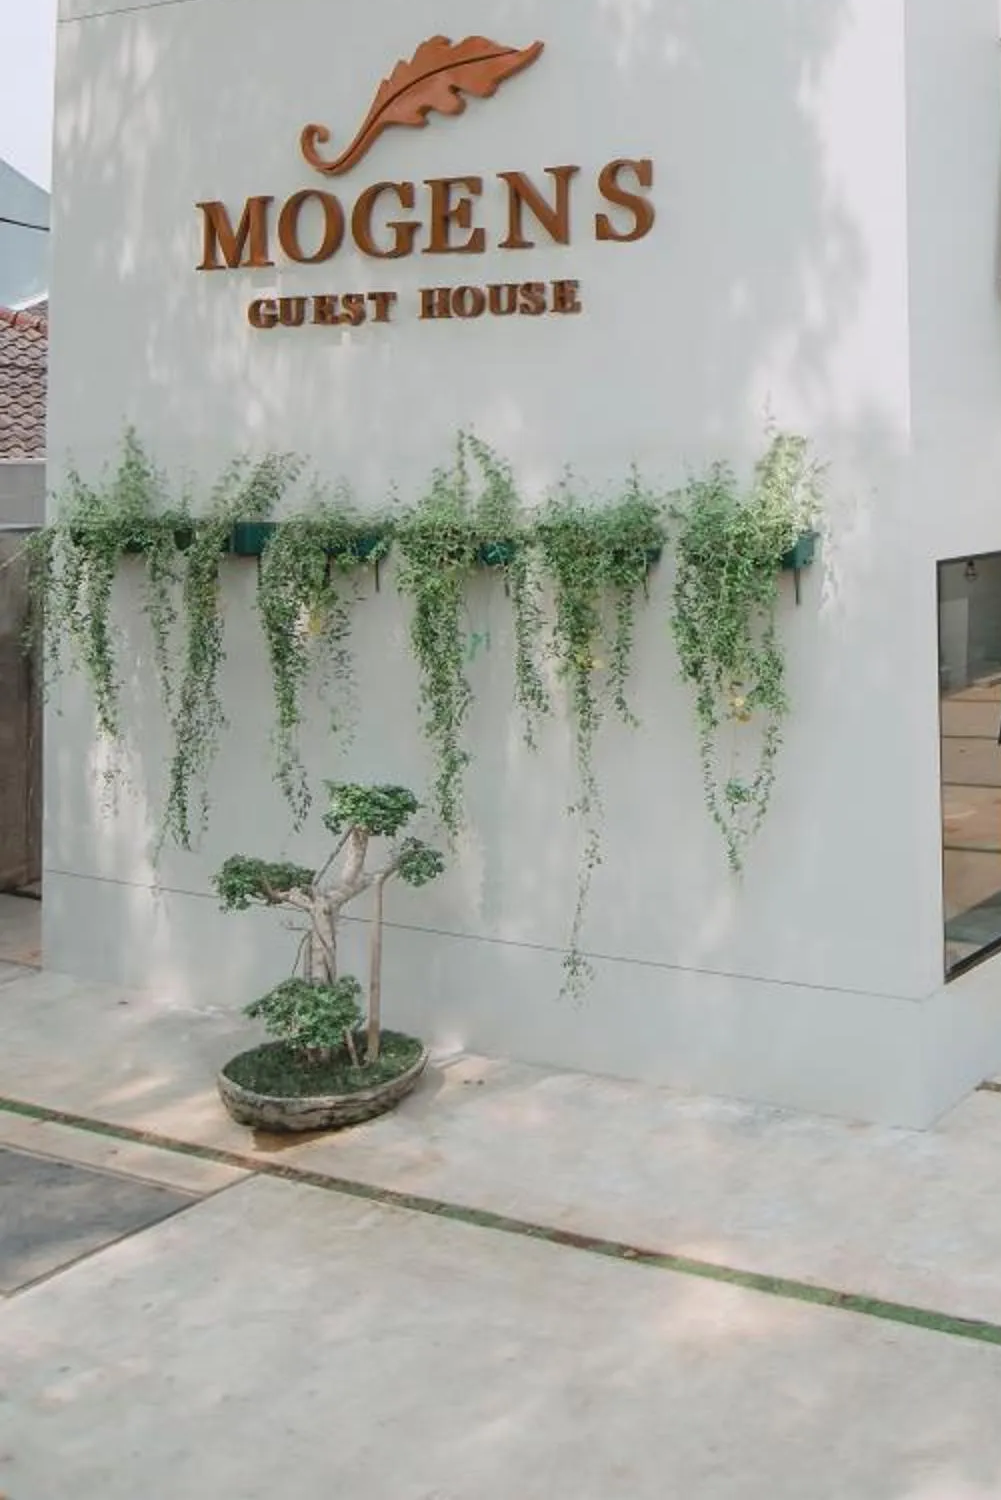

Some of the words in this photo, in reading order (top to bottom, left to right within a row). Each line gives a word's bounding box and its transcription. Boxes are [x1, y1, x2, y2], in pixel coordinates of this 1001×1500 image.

[195, 158, 656, 270] MOGENS
[247, 291, 398, 329] GUEST
[418, 279, 582, 319] HOUSE
